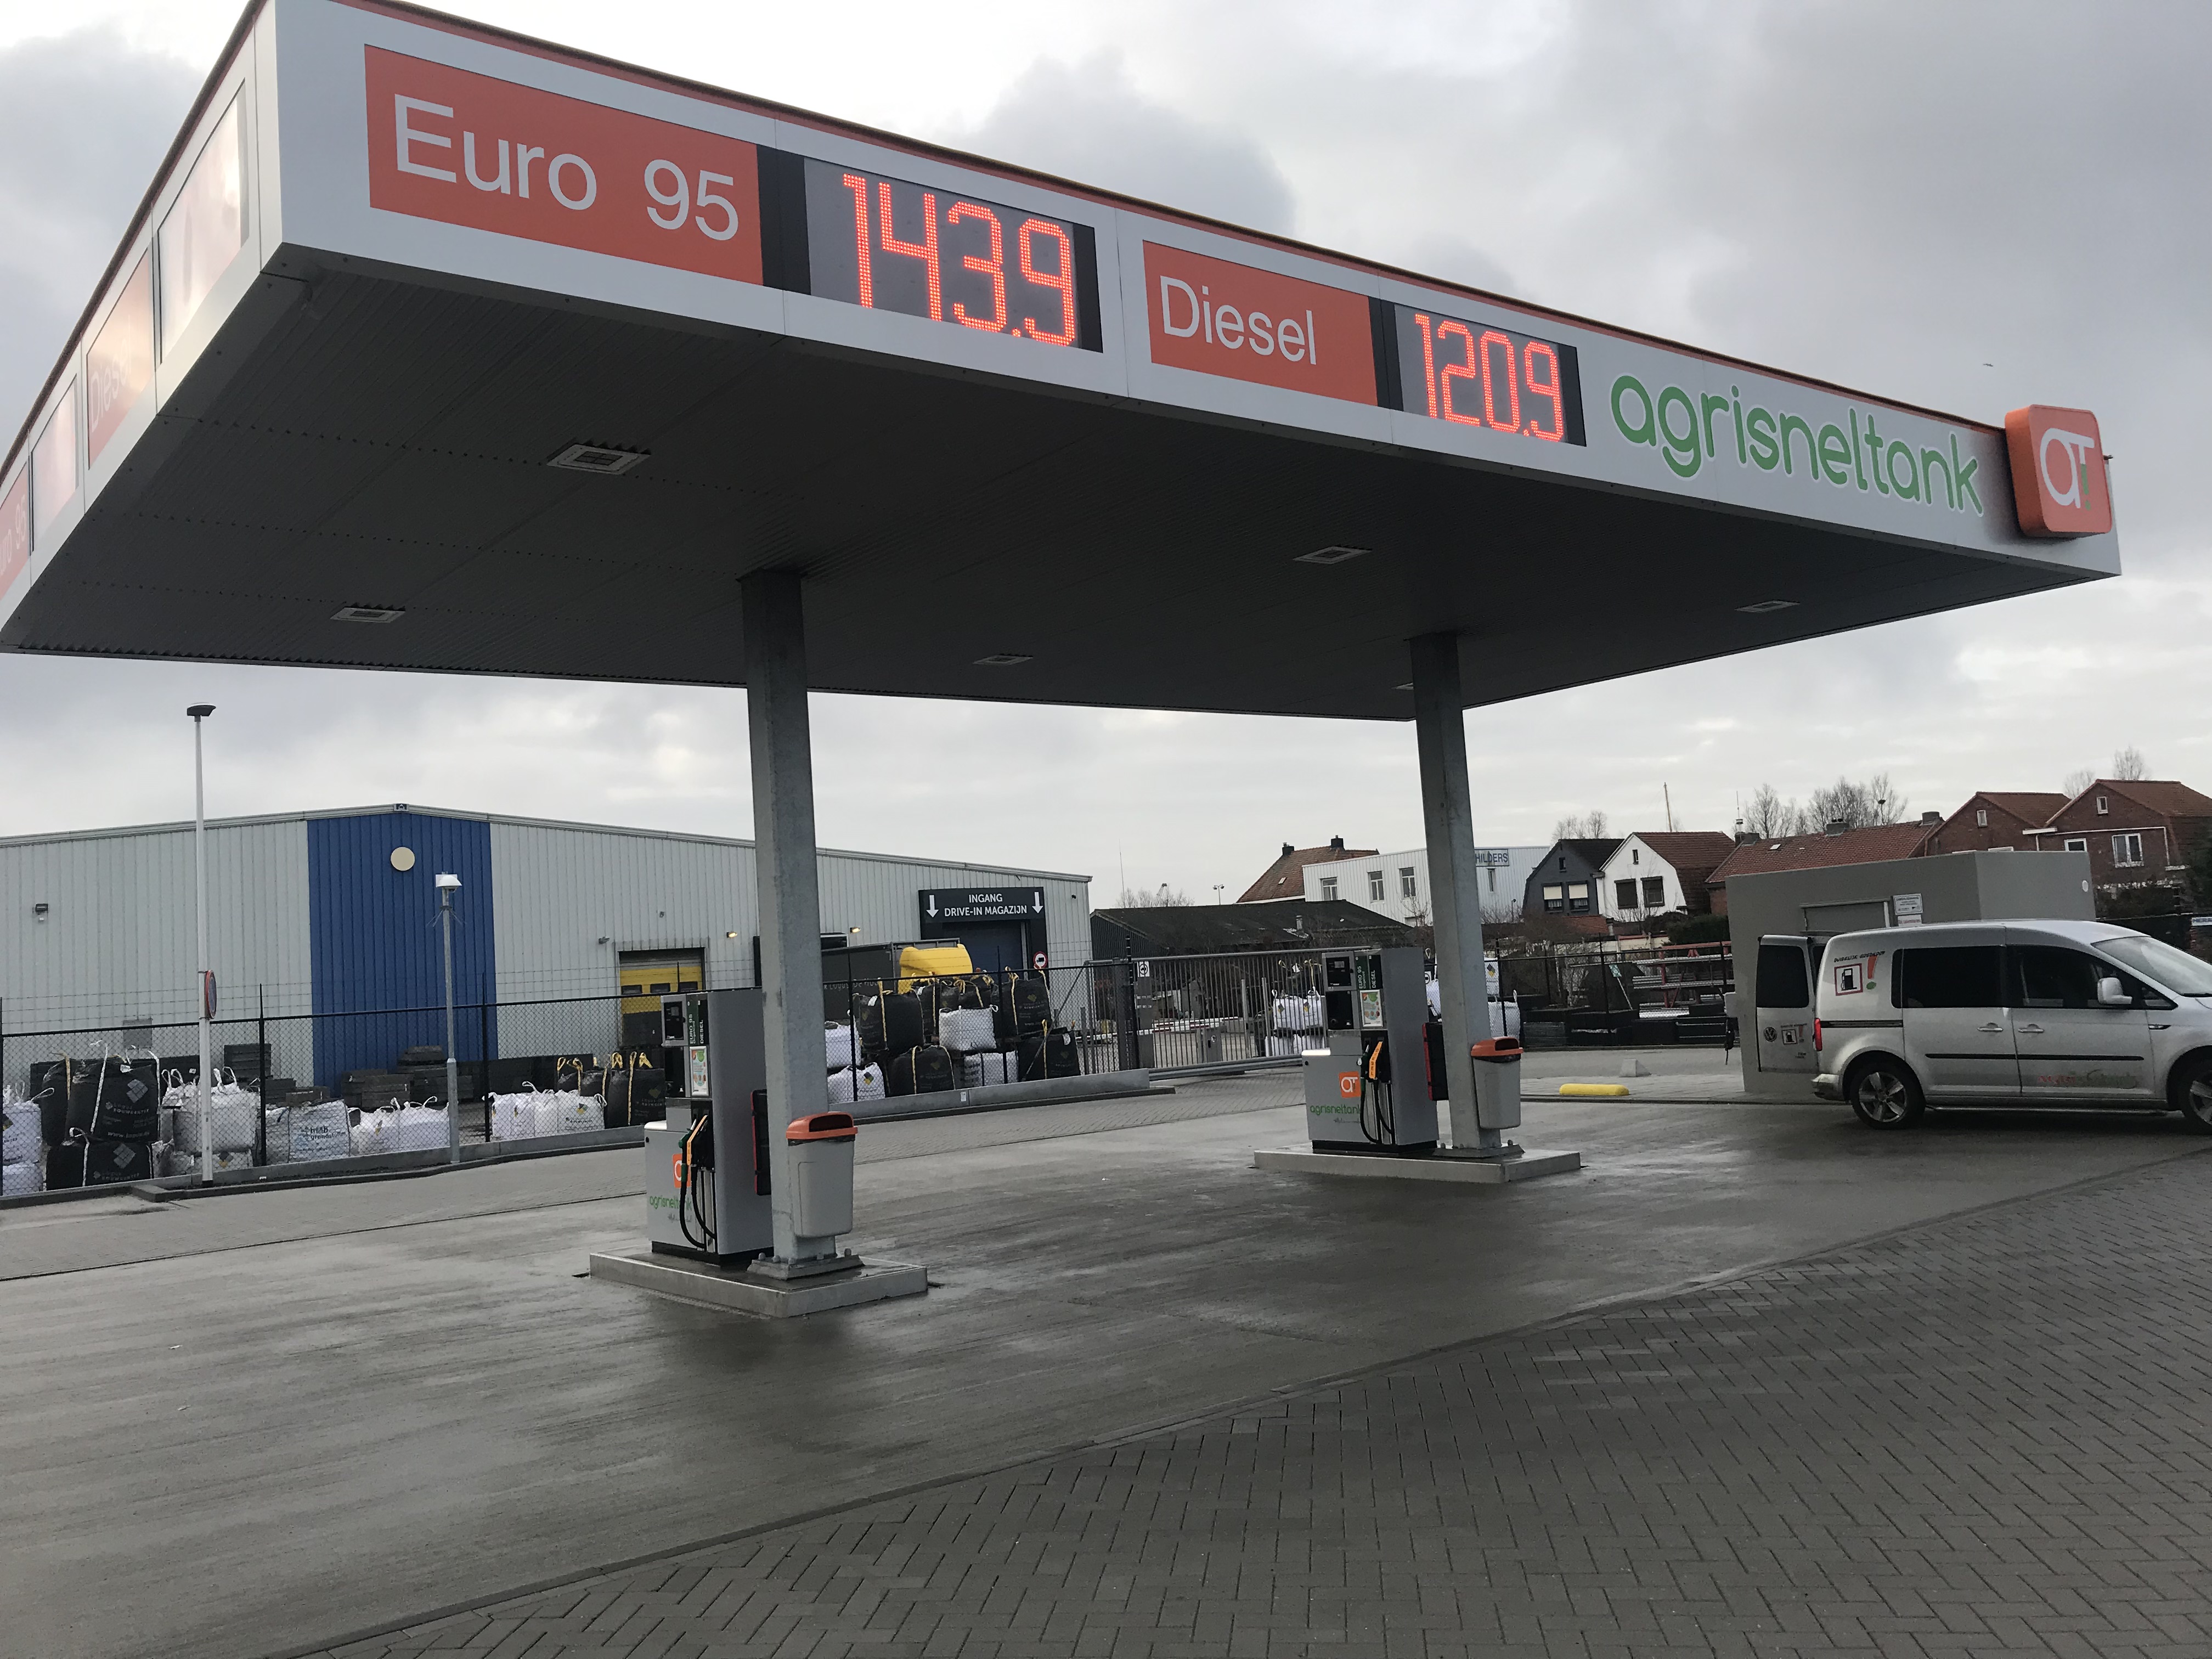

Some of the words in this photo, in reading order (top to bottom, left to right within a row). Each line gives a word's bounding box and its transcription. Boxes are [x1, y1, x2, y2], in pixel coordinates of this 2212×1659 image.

[394, 93, 597, 211] Euro
[644, 159, 739, 241] 95
[843, 172, 1075, 347] 143.9
[91, 314, 132, 433] Diesel
[1160, 275, 1317, 365] Diesel
[1414, 313, 1564, 442] 120.9
[1610, 374, 1984, 516] agrisneltank
[944, 906, 983, 917] DRIVE-IN
[984, 905, 1028, 915] MAGAZIJN
[968, 893, 1003, 903] INGANG
[649, 1194, 693, 1211] agrisneltk
